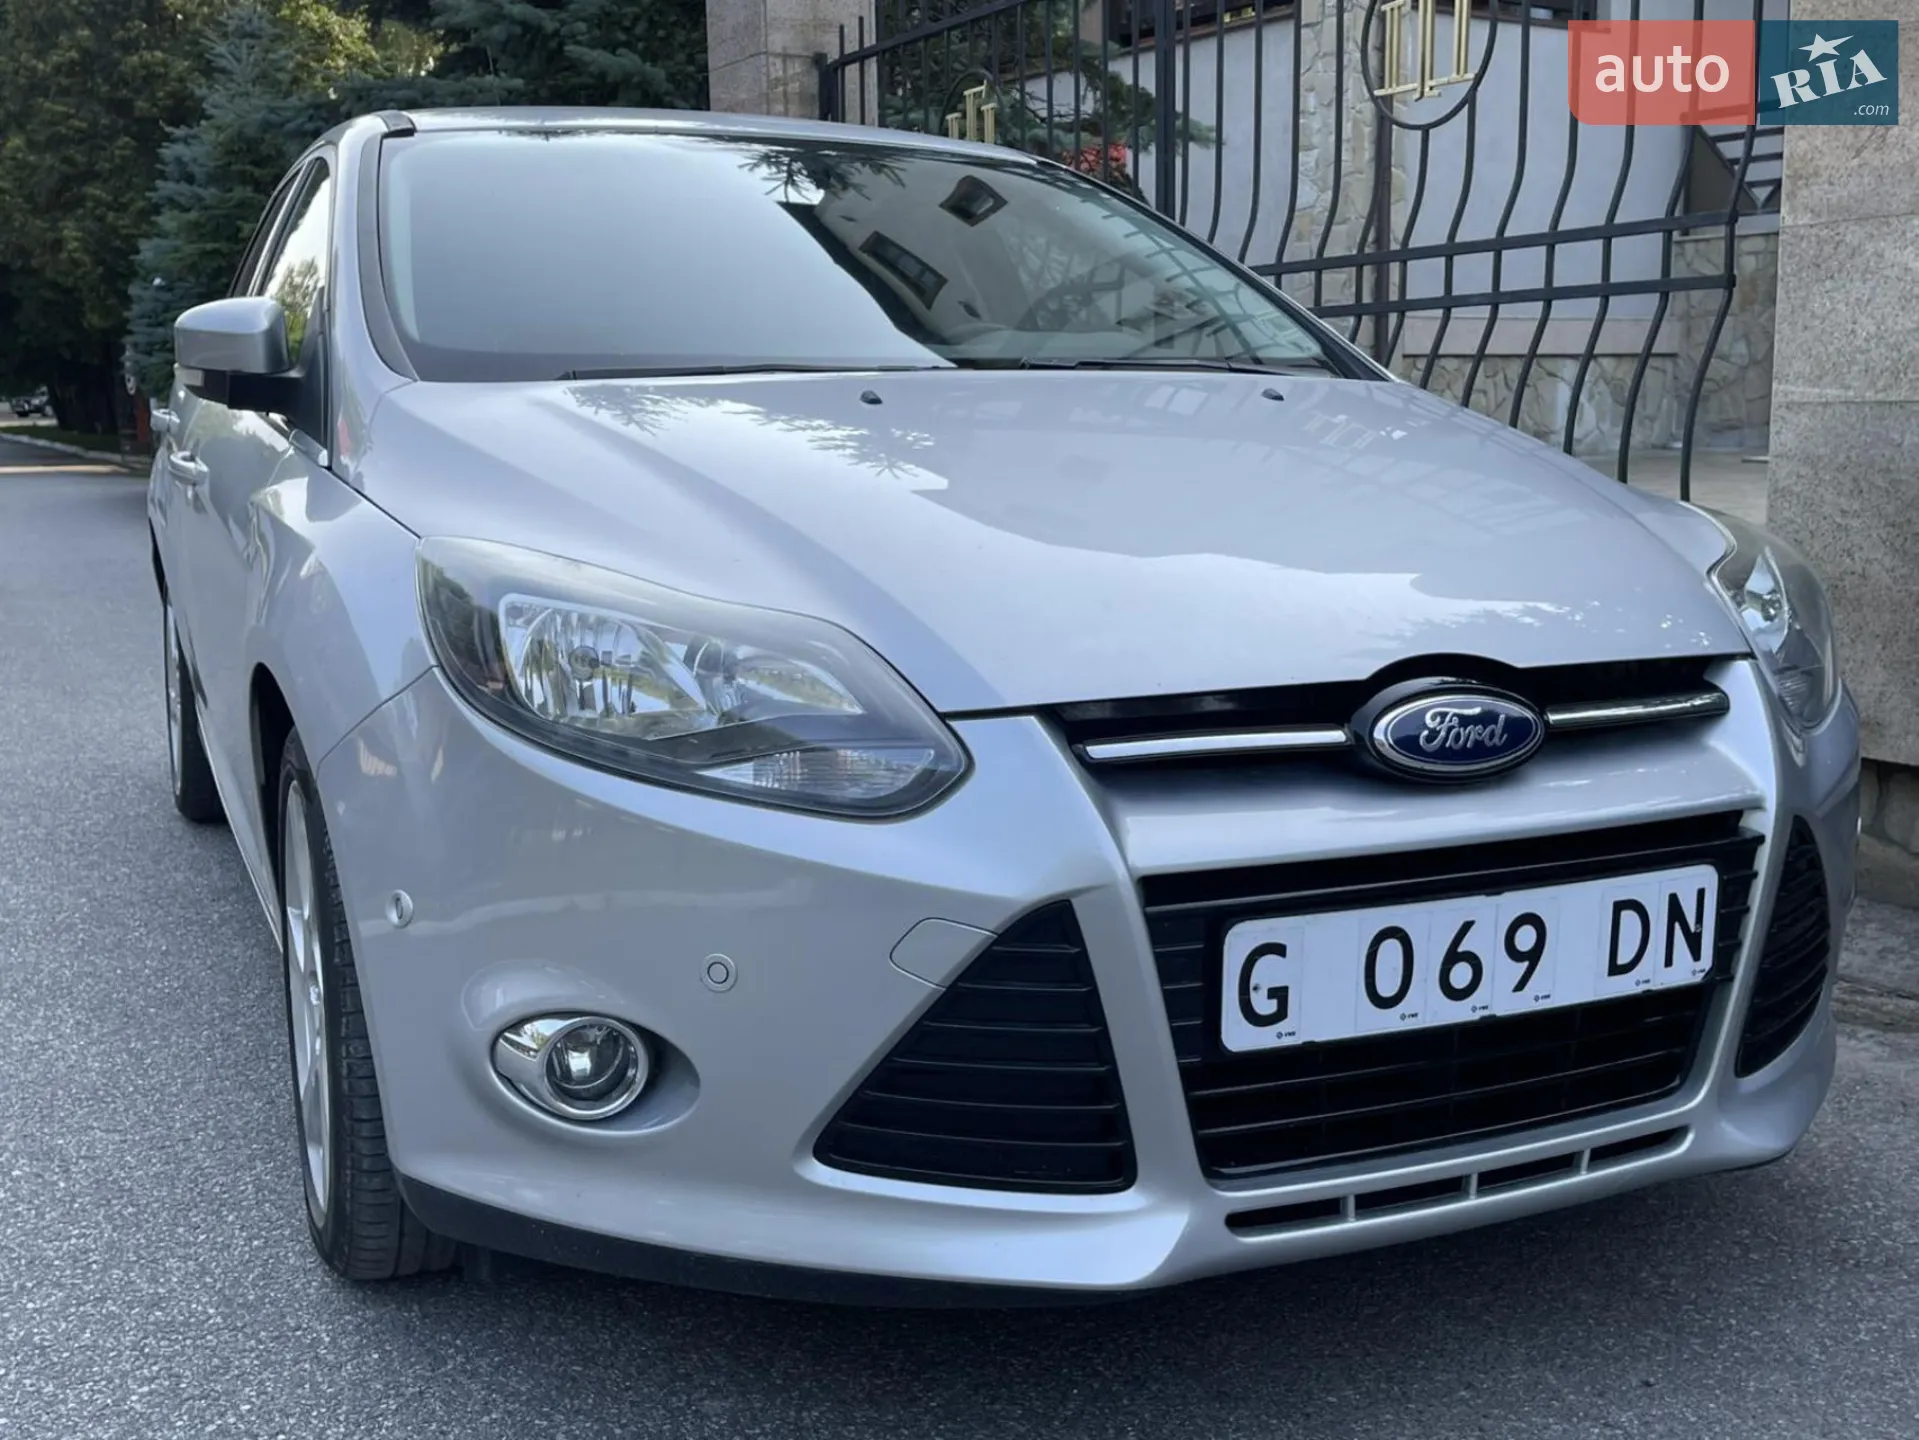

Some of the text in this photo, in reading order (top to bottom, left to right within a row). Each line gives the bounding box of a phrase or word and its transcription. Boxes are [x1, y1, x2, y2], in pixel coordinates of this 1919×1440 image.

[1419, 706, 1508, 752] Ford
[1237, 887, 1706, 1028] G 069 DN
